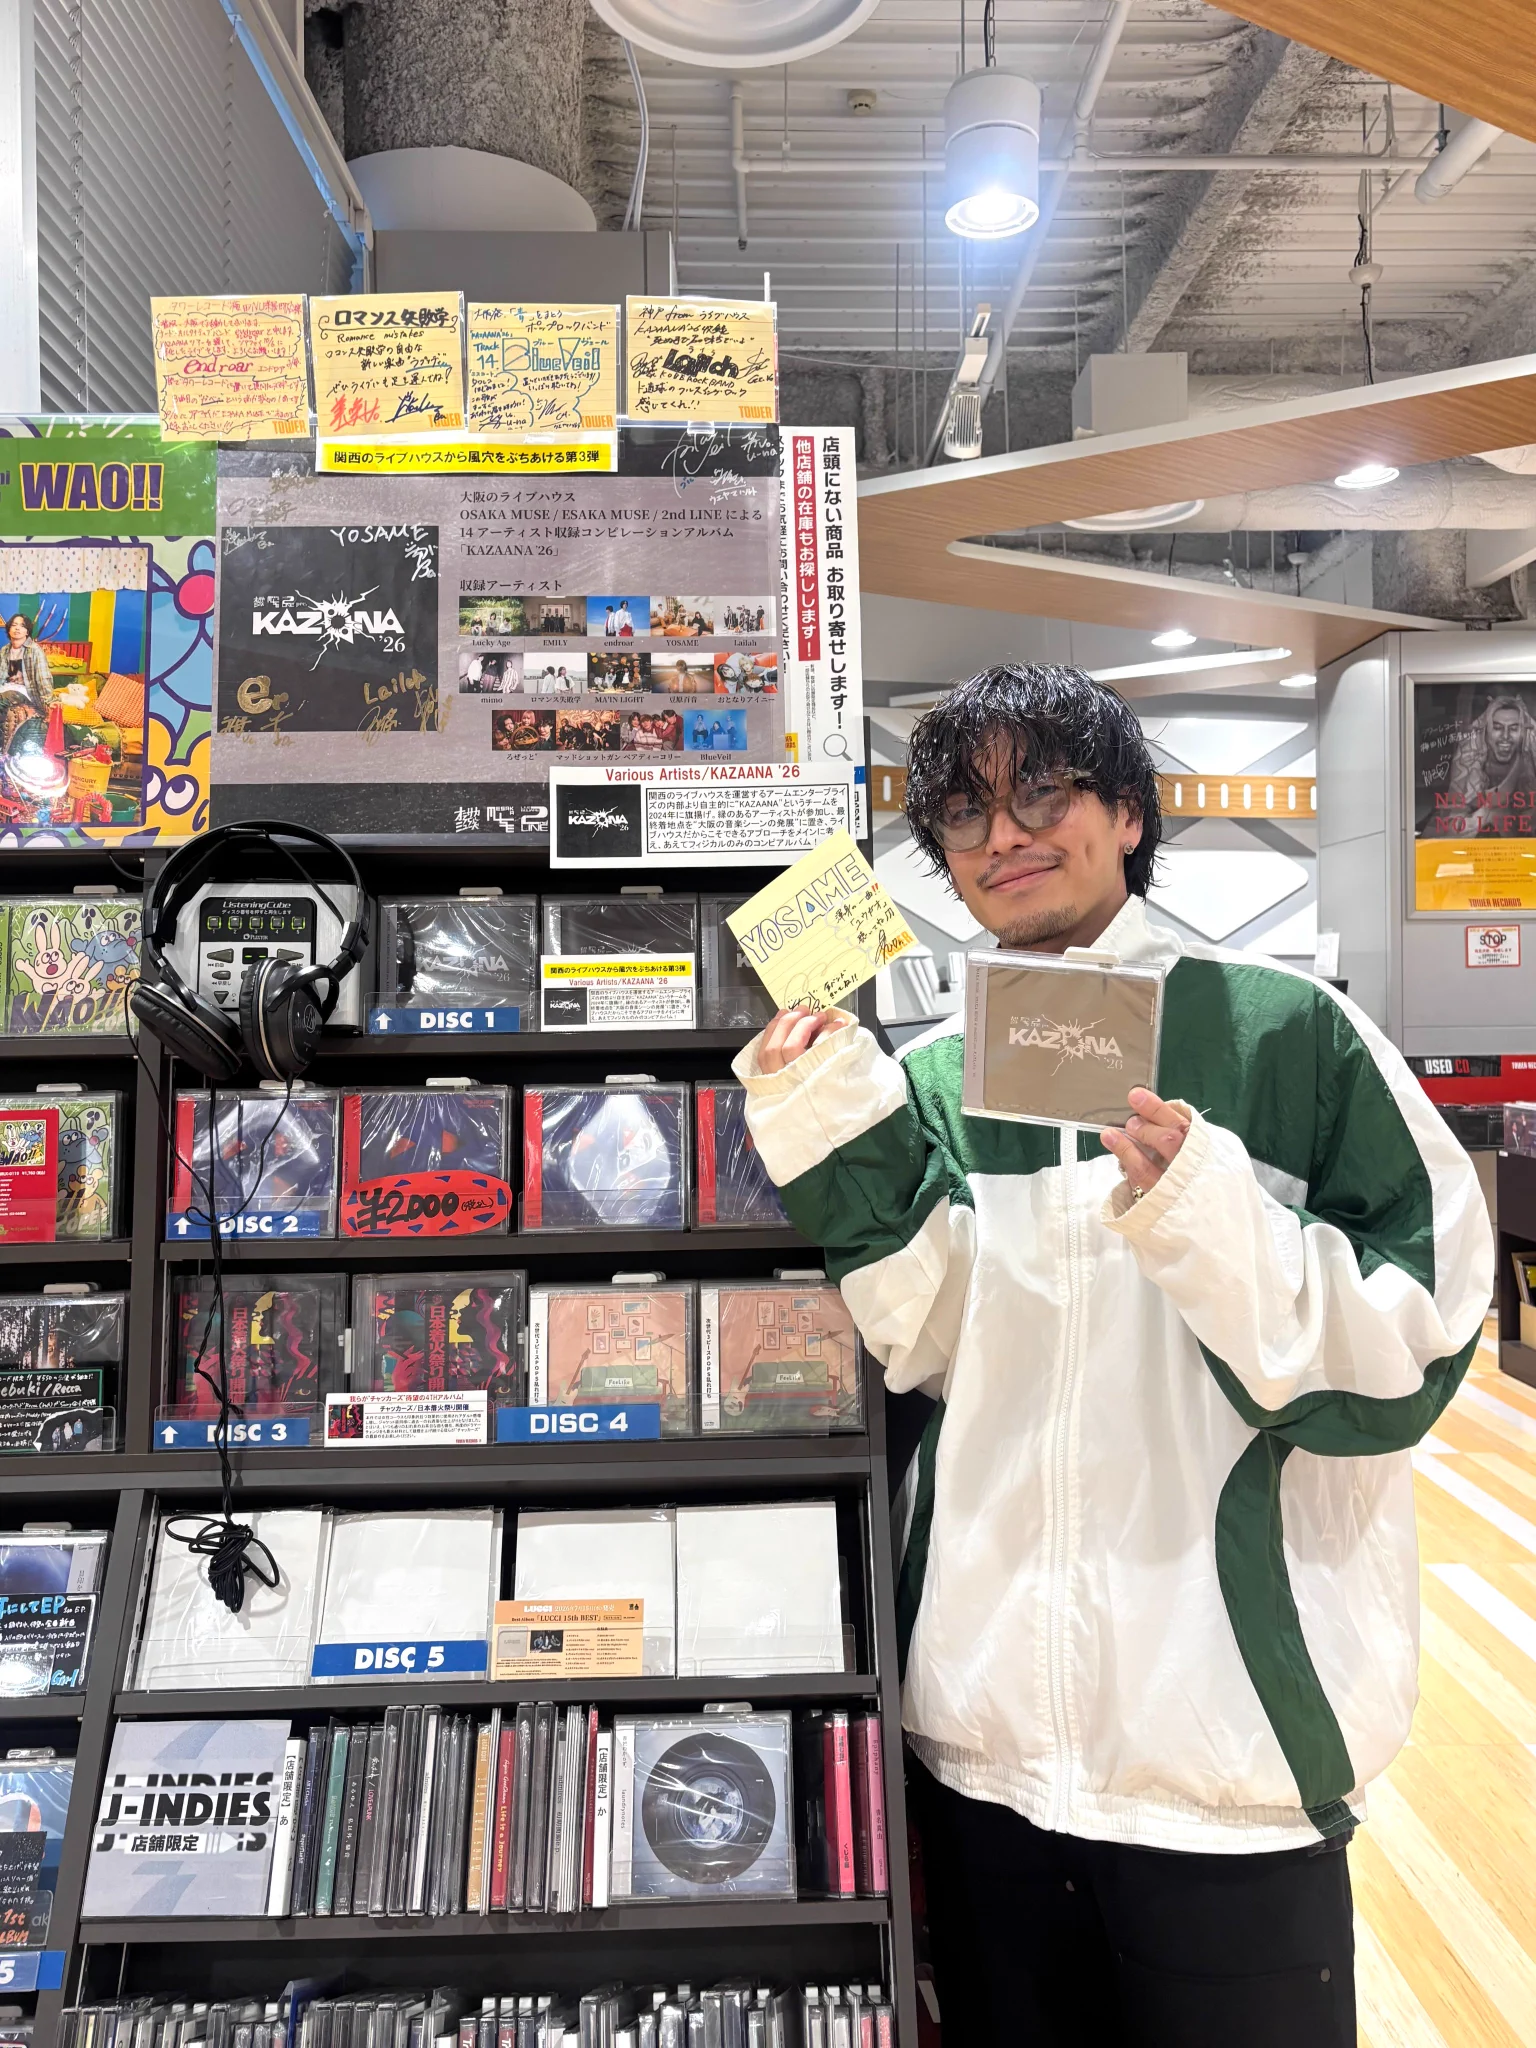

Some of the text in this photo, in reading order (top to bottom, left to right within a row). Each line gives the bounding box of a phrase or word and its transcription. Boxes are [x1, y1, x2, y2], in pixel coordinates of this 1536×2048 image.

[334, 307, 450, 328] ロマンス失敗学
[738, 405, 773, 419] TOWER
[272, 420, 306, 434] TOWER
[580, 415, 613, 428] TOWER
[333, 450, 600, 465] 関西のライブハウスから風穴をぶちあける第3弾
[19, 461, 165, 511] WAO!!
[460, 491, 576, 504] 大阪のライブハウス
[460, 509, 507, 521] OSAKA
[510, 509, 550, 521] MUSE
[561, 509, 607, 521] ESAKA
[610, 508, 650, 521] MUSE
[661, 508, 686, 520] 2nd
[689, 508, 723, 520] LINE
[726, 508, 763, 520] による
[330, 521, 430, 548] YOSAME
[459, 526, 734, 539] 14 アーティスト収録コンピレーションアルバム
[460, 579, 562, 592] 収録アーティスト
[822, 436, 848, 731] 店頭にない商品 お取り寄せします!
[379, 636, 406, 653] '26
[472, 639, 511, 648] Lucky Age
[543, 639, 568, 647] EMILY
[603, 639, 634, 647] endroar
[666, 639, 700, 647] YOSAME
[734, 639, 757, 647] Lailah
[480, 696, 503, 704] mimo
[618, 696, 645, 704] LIGHT
[717, 696, 775, 704] おとなりアイニー
[555, 753, 621, 761] マッドショットガン
[700, 753, 732, 761] BlueVeil
[606, 765, 801, 782] Various Artists/KAZAANA '26
[1434, 792, 1467, 810] NO
[1435, 815, 1533, 833] NO LIFE
[222, 901, 292, 909] ListeningCube
[739, 853, 870, 964] YOSAME
[1468, 897, 1523, 908] TOWER RECORDS
[1479, 934, 1507, 946] STOP
[568, 978, 594, 987] Various
[419, 1011, 496, 1029] DISC 1
[1424, 1058, 1471, 1075] USED CD
[218, 1215, 299, 1234] DISC 2
[530, 1411, 628, 1434] DISC 4
[207, 1423, 288, 1443] DISC 3
[355, 1646, 445, 1670] DISC 5
[596, 1746, 609, 1818] 【店舗限定】 か
[279, 1754, 297, 1826] 【店舗限定】 あ
[101, 1792, 272, 1827] J-INDIES
[619, 1789, 627, 1829] laundrynotes
[131, 1833, 200, 1853] 店舗限定
